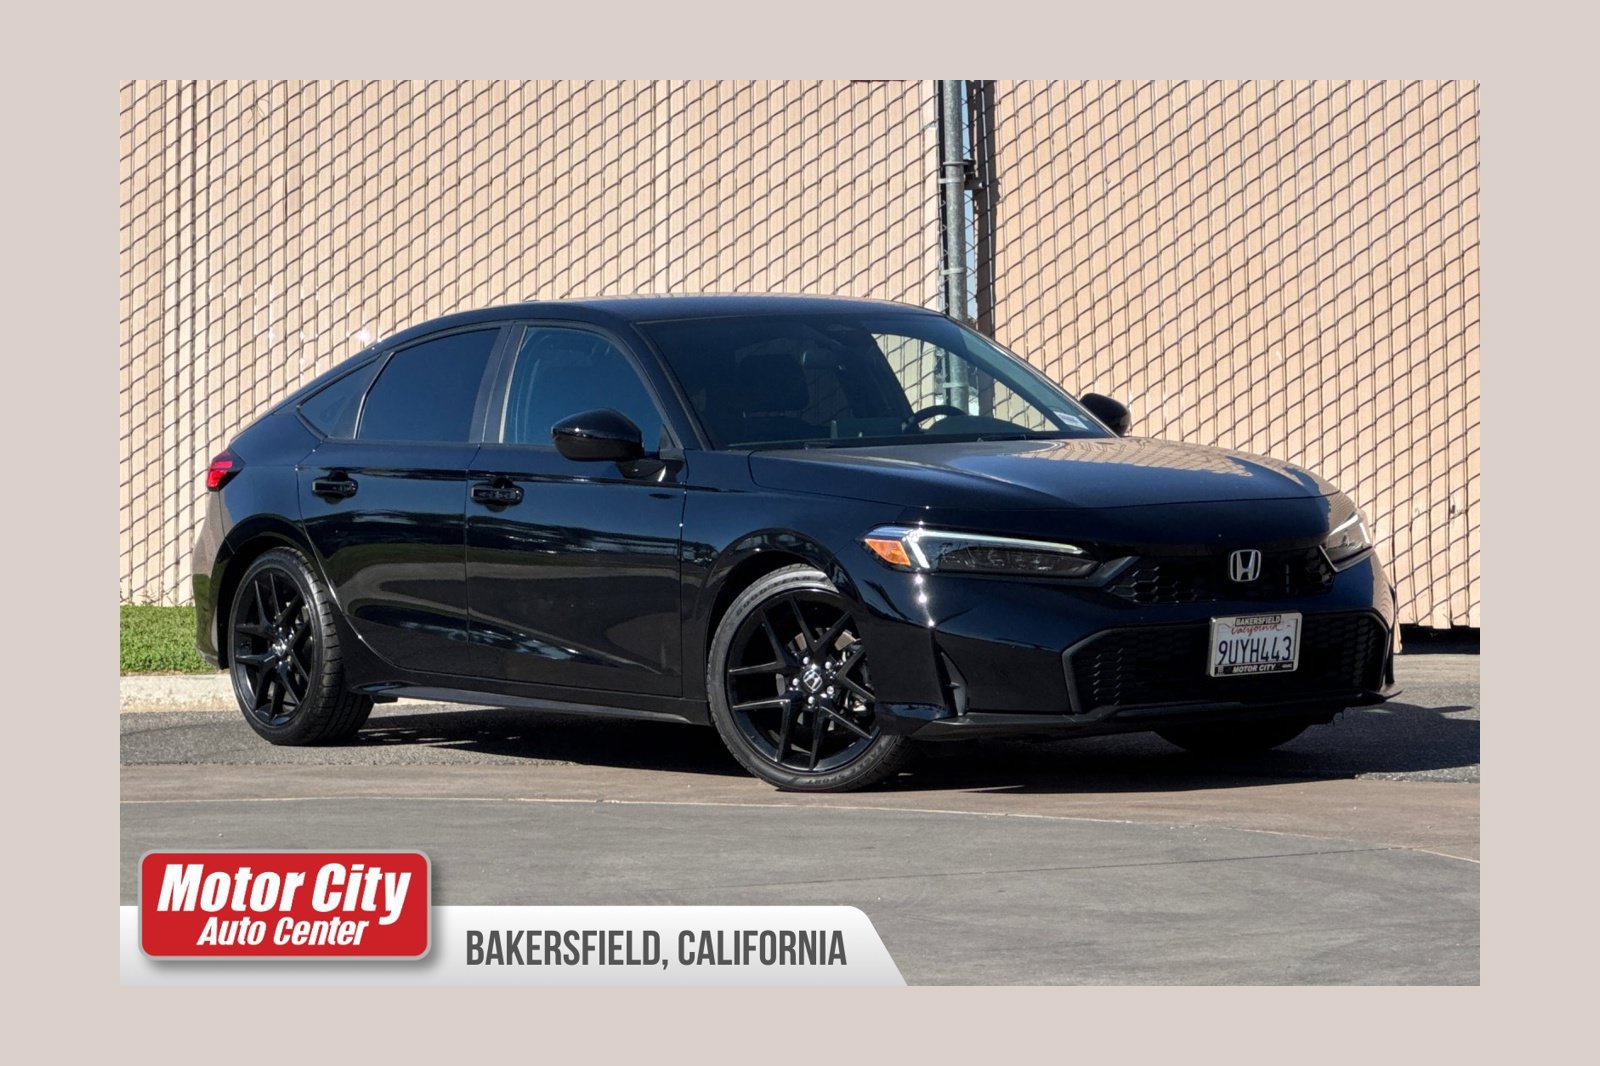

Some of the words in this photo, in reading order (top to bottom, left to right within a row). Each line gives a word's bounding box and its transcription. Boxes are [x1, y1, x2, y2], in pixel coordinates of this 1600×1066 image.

[1235, 615, 1281, 626] BAKERSFIELD
[1231, 624, 1282, 637] California
[1218, 636, 1292, 665] 9UYH443
[1232, 665, 1258, 674] MOTOR
[1258, 664, 1276, 672] CITY
